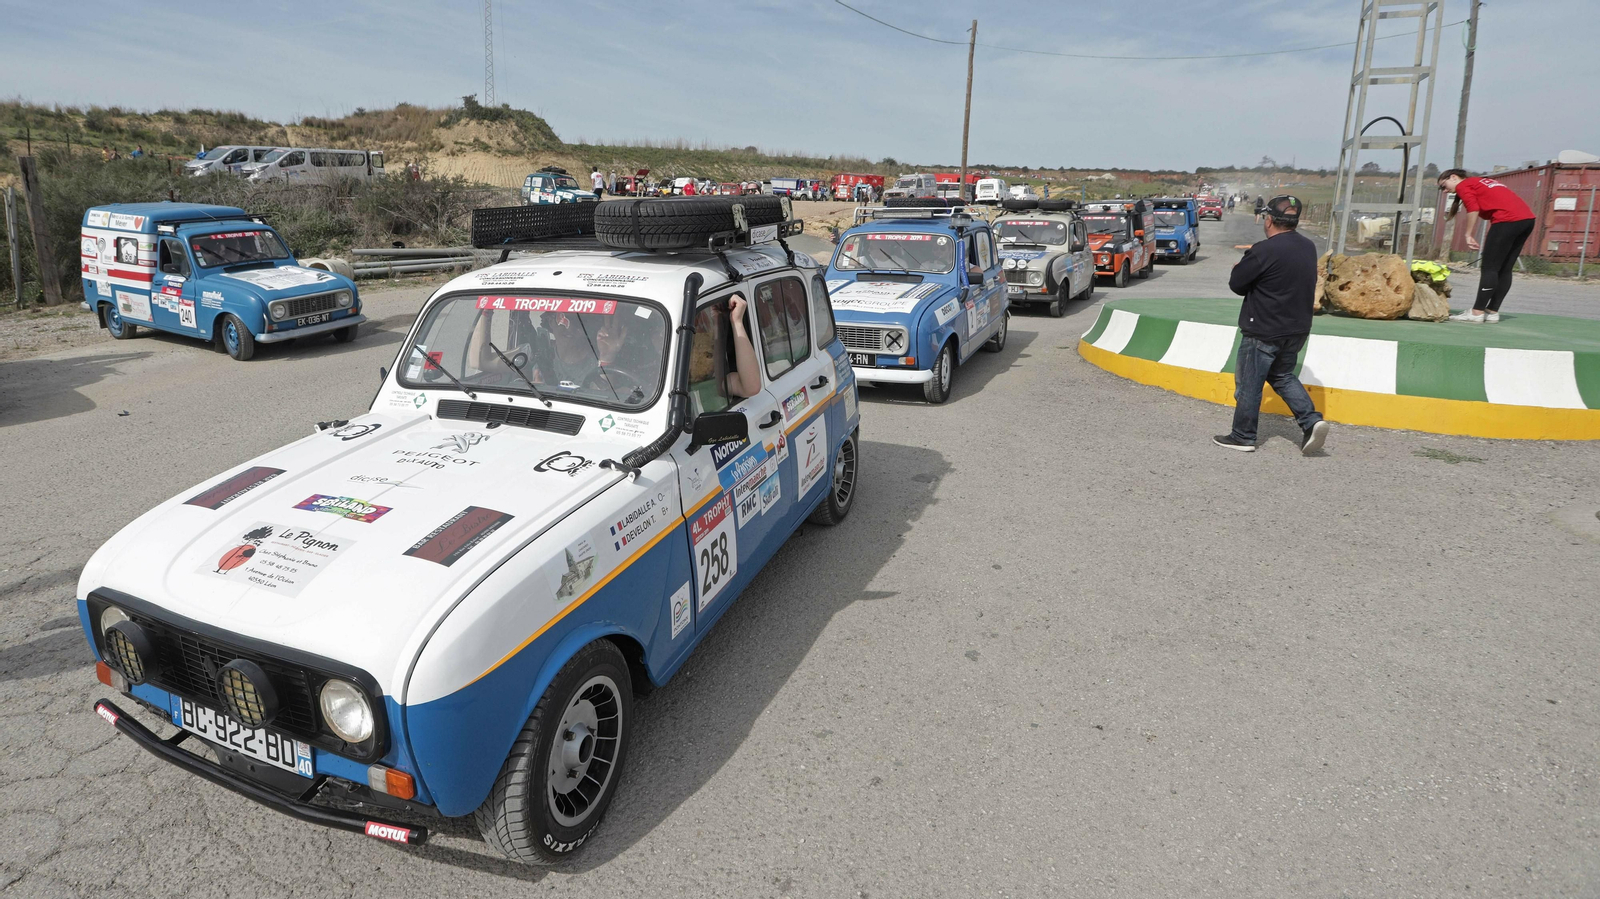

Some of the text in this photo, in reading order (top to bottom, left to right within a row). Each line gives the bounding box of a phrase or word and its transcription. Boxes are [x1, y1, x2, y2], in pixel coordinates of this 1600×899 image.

[751, 228, 766, 239] dicase
[180, 308, 193, 324] 240
[492, 298, 596, 313] 4L TROPHY 2019
[297, 313, 330, 326] EK-036-NT
[392, 449, 481, 467] PEUGEOT
[735, 464, 768, 499] Intermarché
[621, 502, 653, 528] LABIDALLE
[692, 493, 731, 535] 4L TROPHY
[741, 493, 758, 519] RMC
[279, 528, 339, 552] Le Pignon
[412, 538, 429, 550] BAR
[427, 511, 469, 540] RESTAURANT
[626, 518, 652, 543] DEVELON
[700, 531, 729, 597] 258
[97, 706, 116, 725] MOTUL
[299, 758, 313, 776] 40
[367, 824, 407, 842] MOTUL
